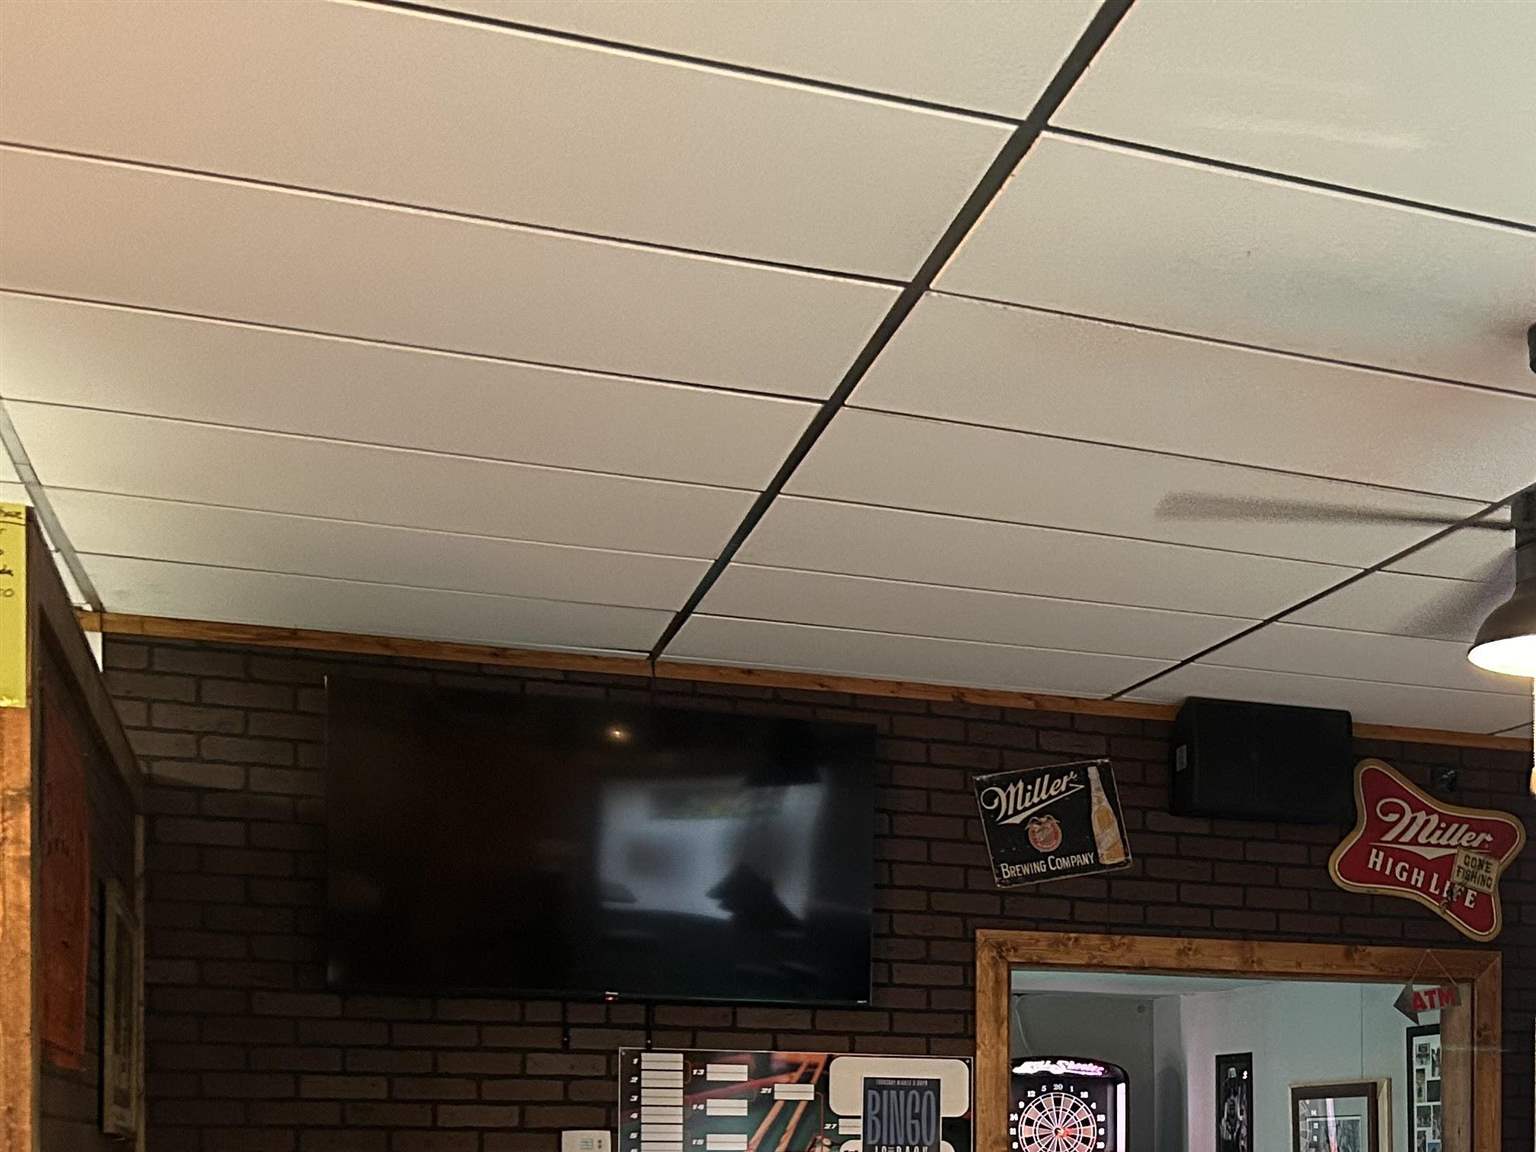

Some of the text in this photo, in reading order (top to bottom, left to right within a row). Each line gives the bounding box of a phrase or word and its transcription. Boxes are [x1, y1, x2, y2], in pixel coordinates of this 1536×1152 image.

[980, 770, 1079, 822] Miller
[1376, 797, 1493, 848] Miller
[1000, 851, 1095, 880] BREWING COMPANY
[1367, 847, 1477, 908] HIGH LIFE
[1456, 865, 1493, 889] FISHING
[1463, 853, 1493, 873] GONE
[1412, 987, 1457, 1011] ATM
[866, 1089, 937, 1146] BINGO
